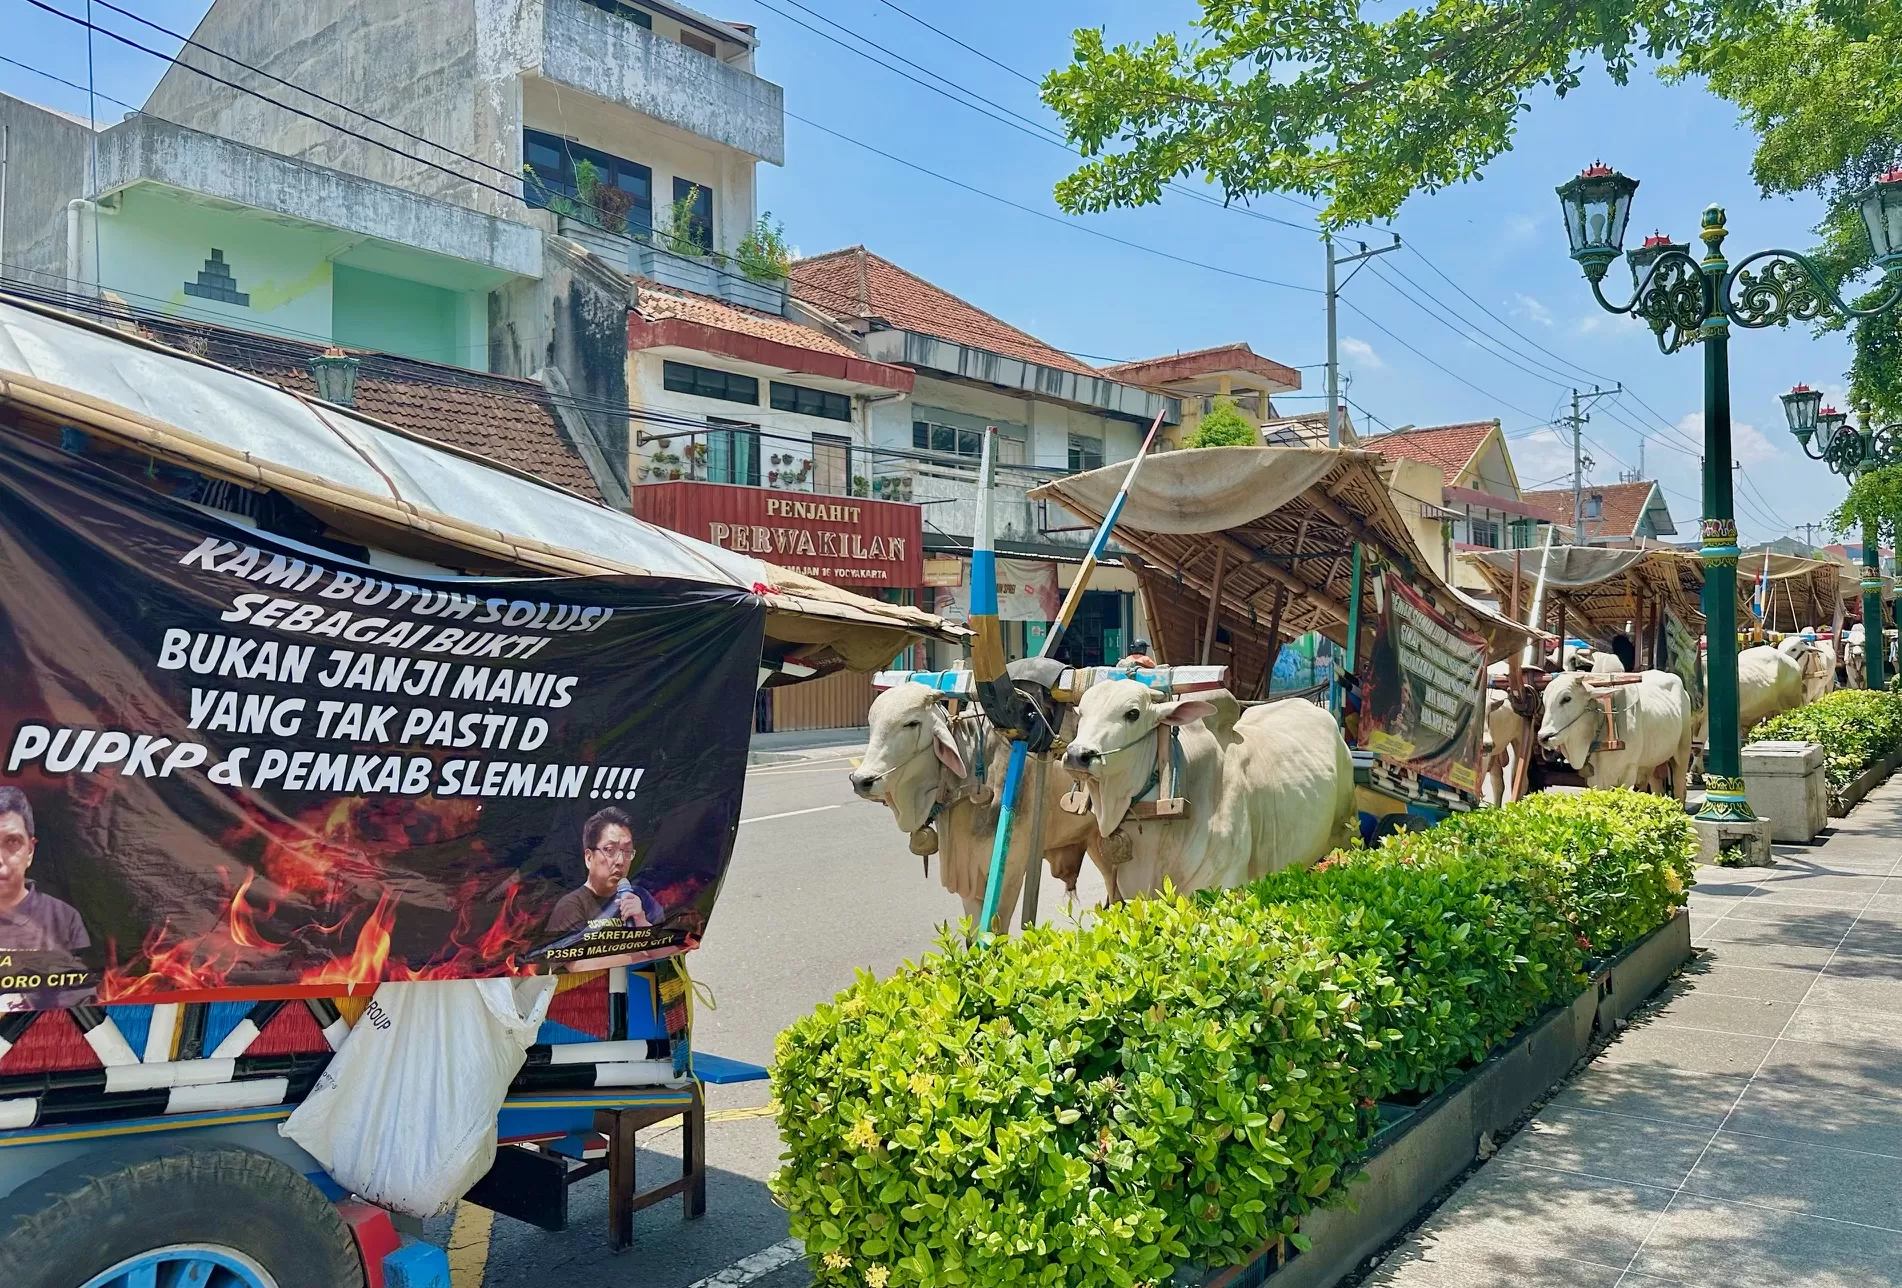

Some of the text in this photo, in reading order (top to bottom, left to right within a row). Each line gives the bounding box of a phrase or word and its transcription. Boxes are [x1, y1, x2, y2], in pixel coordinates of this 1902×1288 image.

[766, 499, 861, 524] PENJAHIT
[709, 522, 906, 562] PERWAKILAN
[178, 537, 614, 632] KAMI BUTUH SOLUSI
[782, 565, 820, 576] MAJAN
[834, 568, 887, 579] YOGYAKARTA
[220, 593, 552, 660] SEBAGAI BUKTI
[157, 628, 579, 708] BUKAN JANJI MANIS
[186, 688, 549, 751] YANG TAK PASTI D
[7, 725, 646, 800] PUPKP & PEMKAB SLEMAN !!!!
[546, 934, 675, 959] P3SRS MALIOBORO CITY
[583, 929, 652, 941] SEKRETARIS
[47, 973, 89, 987] CITY
